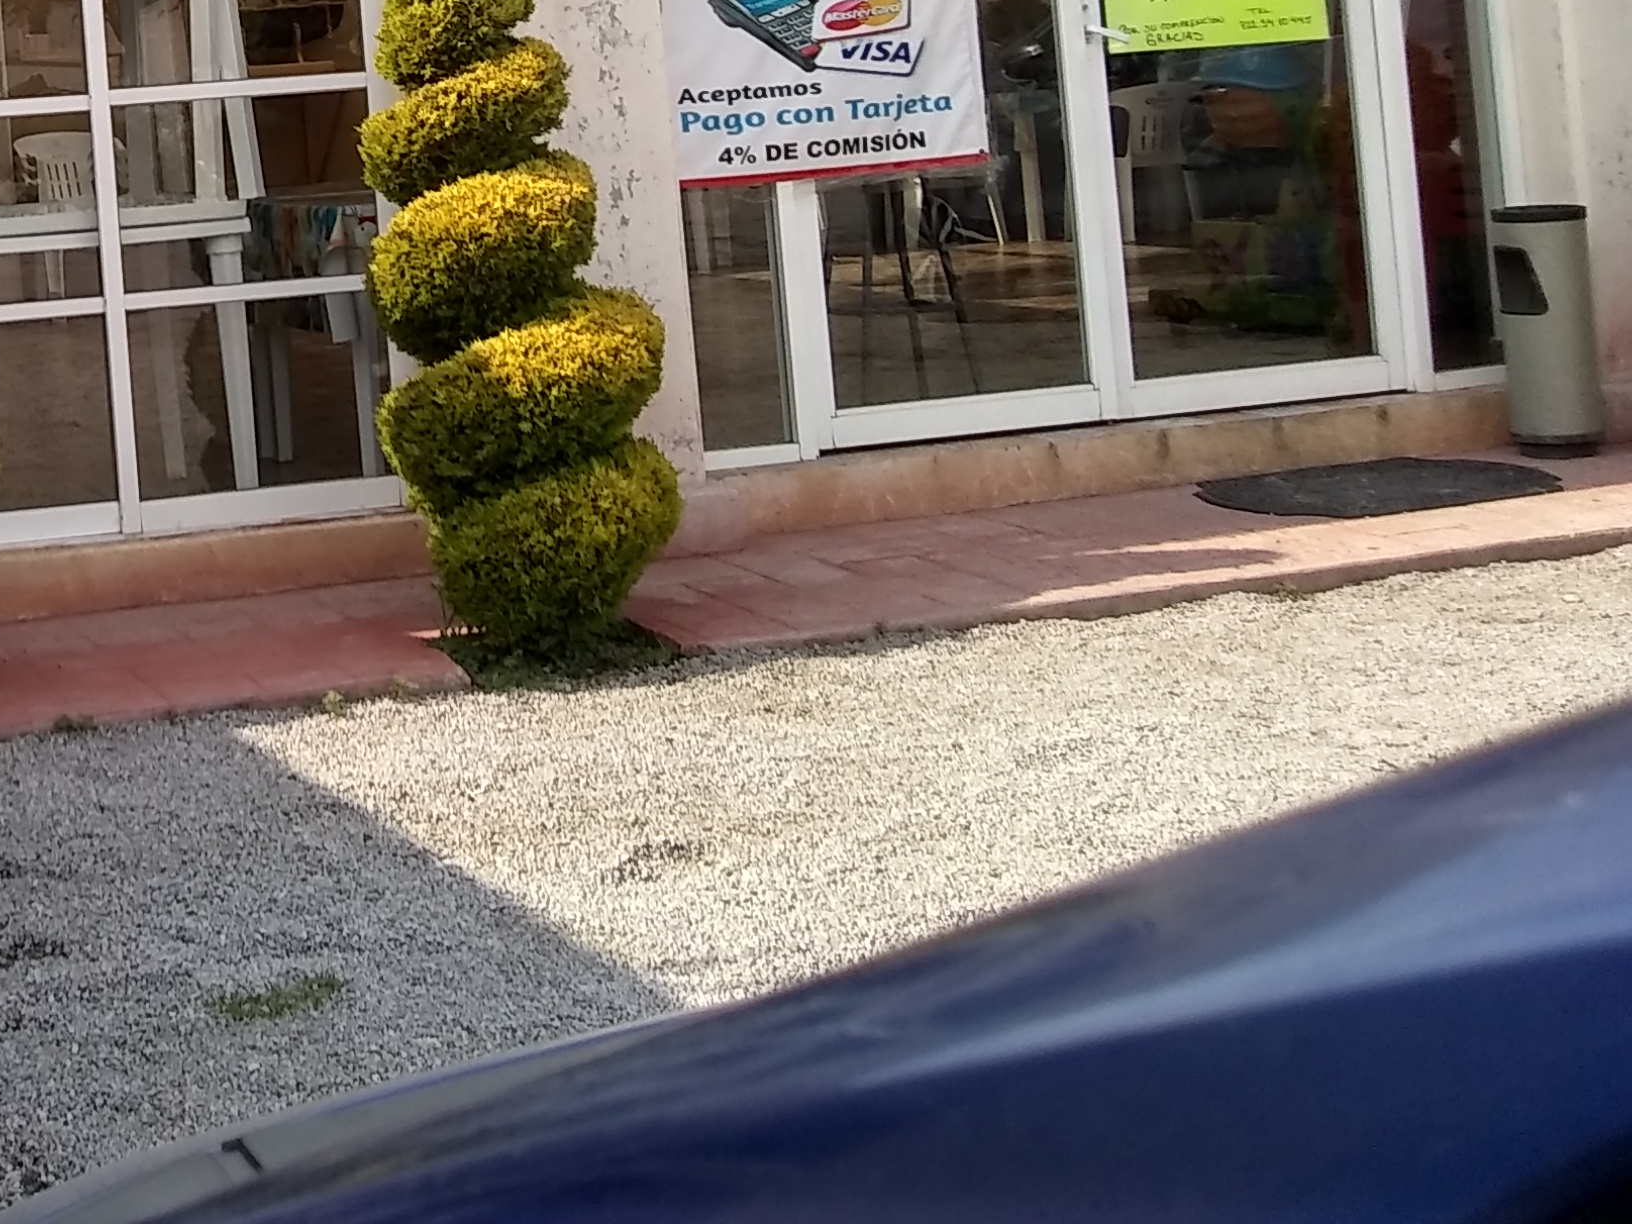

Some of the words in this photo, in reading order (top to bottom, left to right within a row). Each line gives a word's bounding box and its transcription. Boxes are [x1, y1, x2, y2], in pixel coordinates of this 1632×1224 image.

[1146, 31, 1204, 47] GRACIAS
[841, 40, 912, 64] VISA
[678, 82, 822, 105] Aceptamos
[680, 109, 765, 135] Pago
[776, 104, 834, 125] con
[845, 94, 952, 122] Tarjeta
[718, 145, 757, 166] 4%
[765, 142, 798, 162] DE
[807, 129, 926, 157] COMISIÓN
